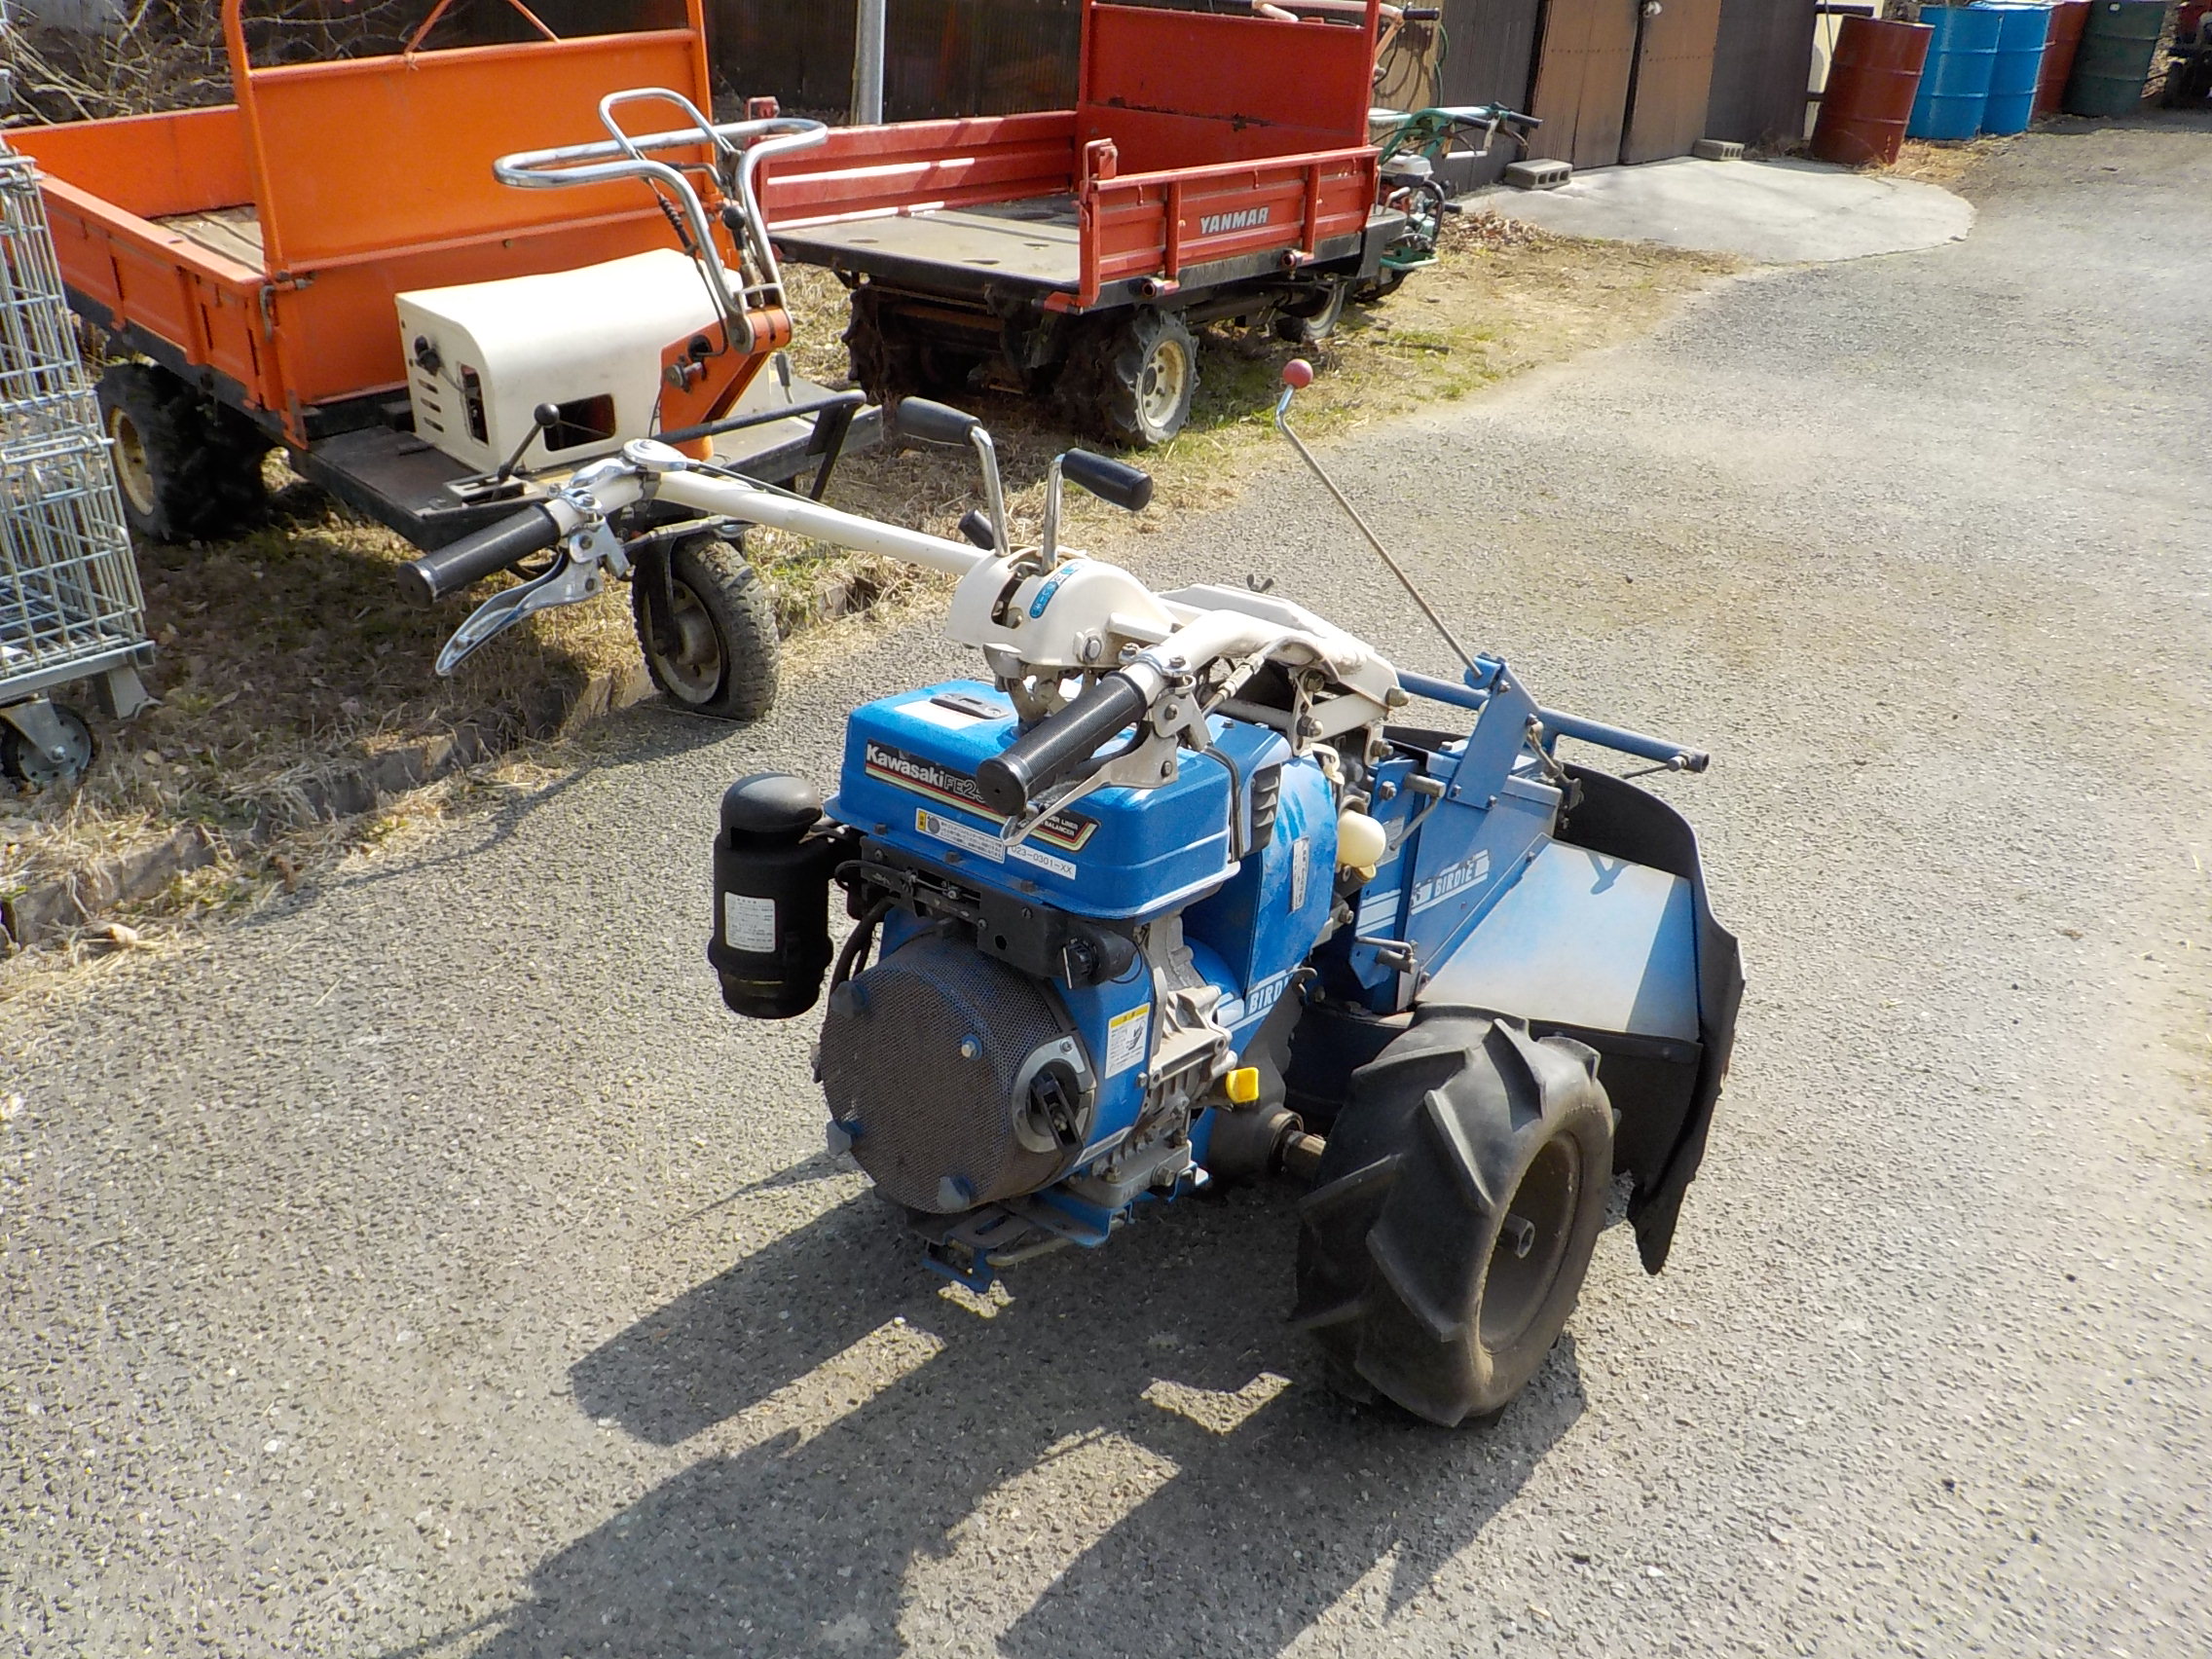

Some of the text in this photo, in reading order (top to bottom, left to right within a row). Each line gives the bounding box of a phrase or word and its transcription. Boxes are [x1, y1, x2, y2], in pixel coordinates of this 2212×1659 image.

[1200, 207, 1269, 234] YANMAR
[866, 744, 944, 788] Kawasaki
[1045, 821, 1075, 836] BALANCER
[1434, 864, 1474, 897] BIRDIE
